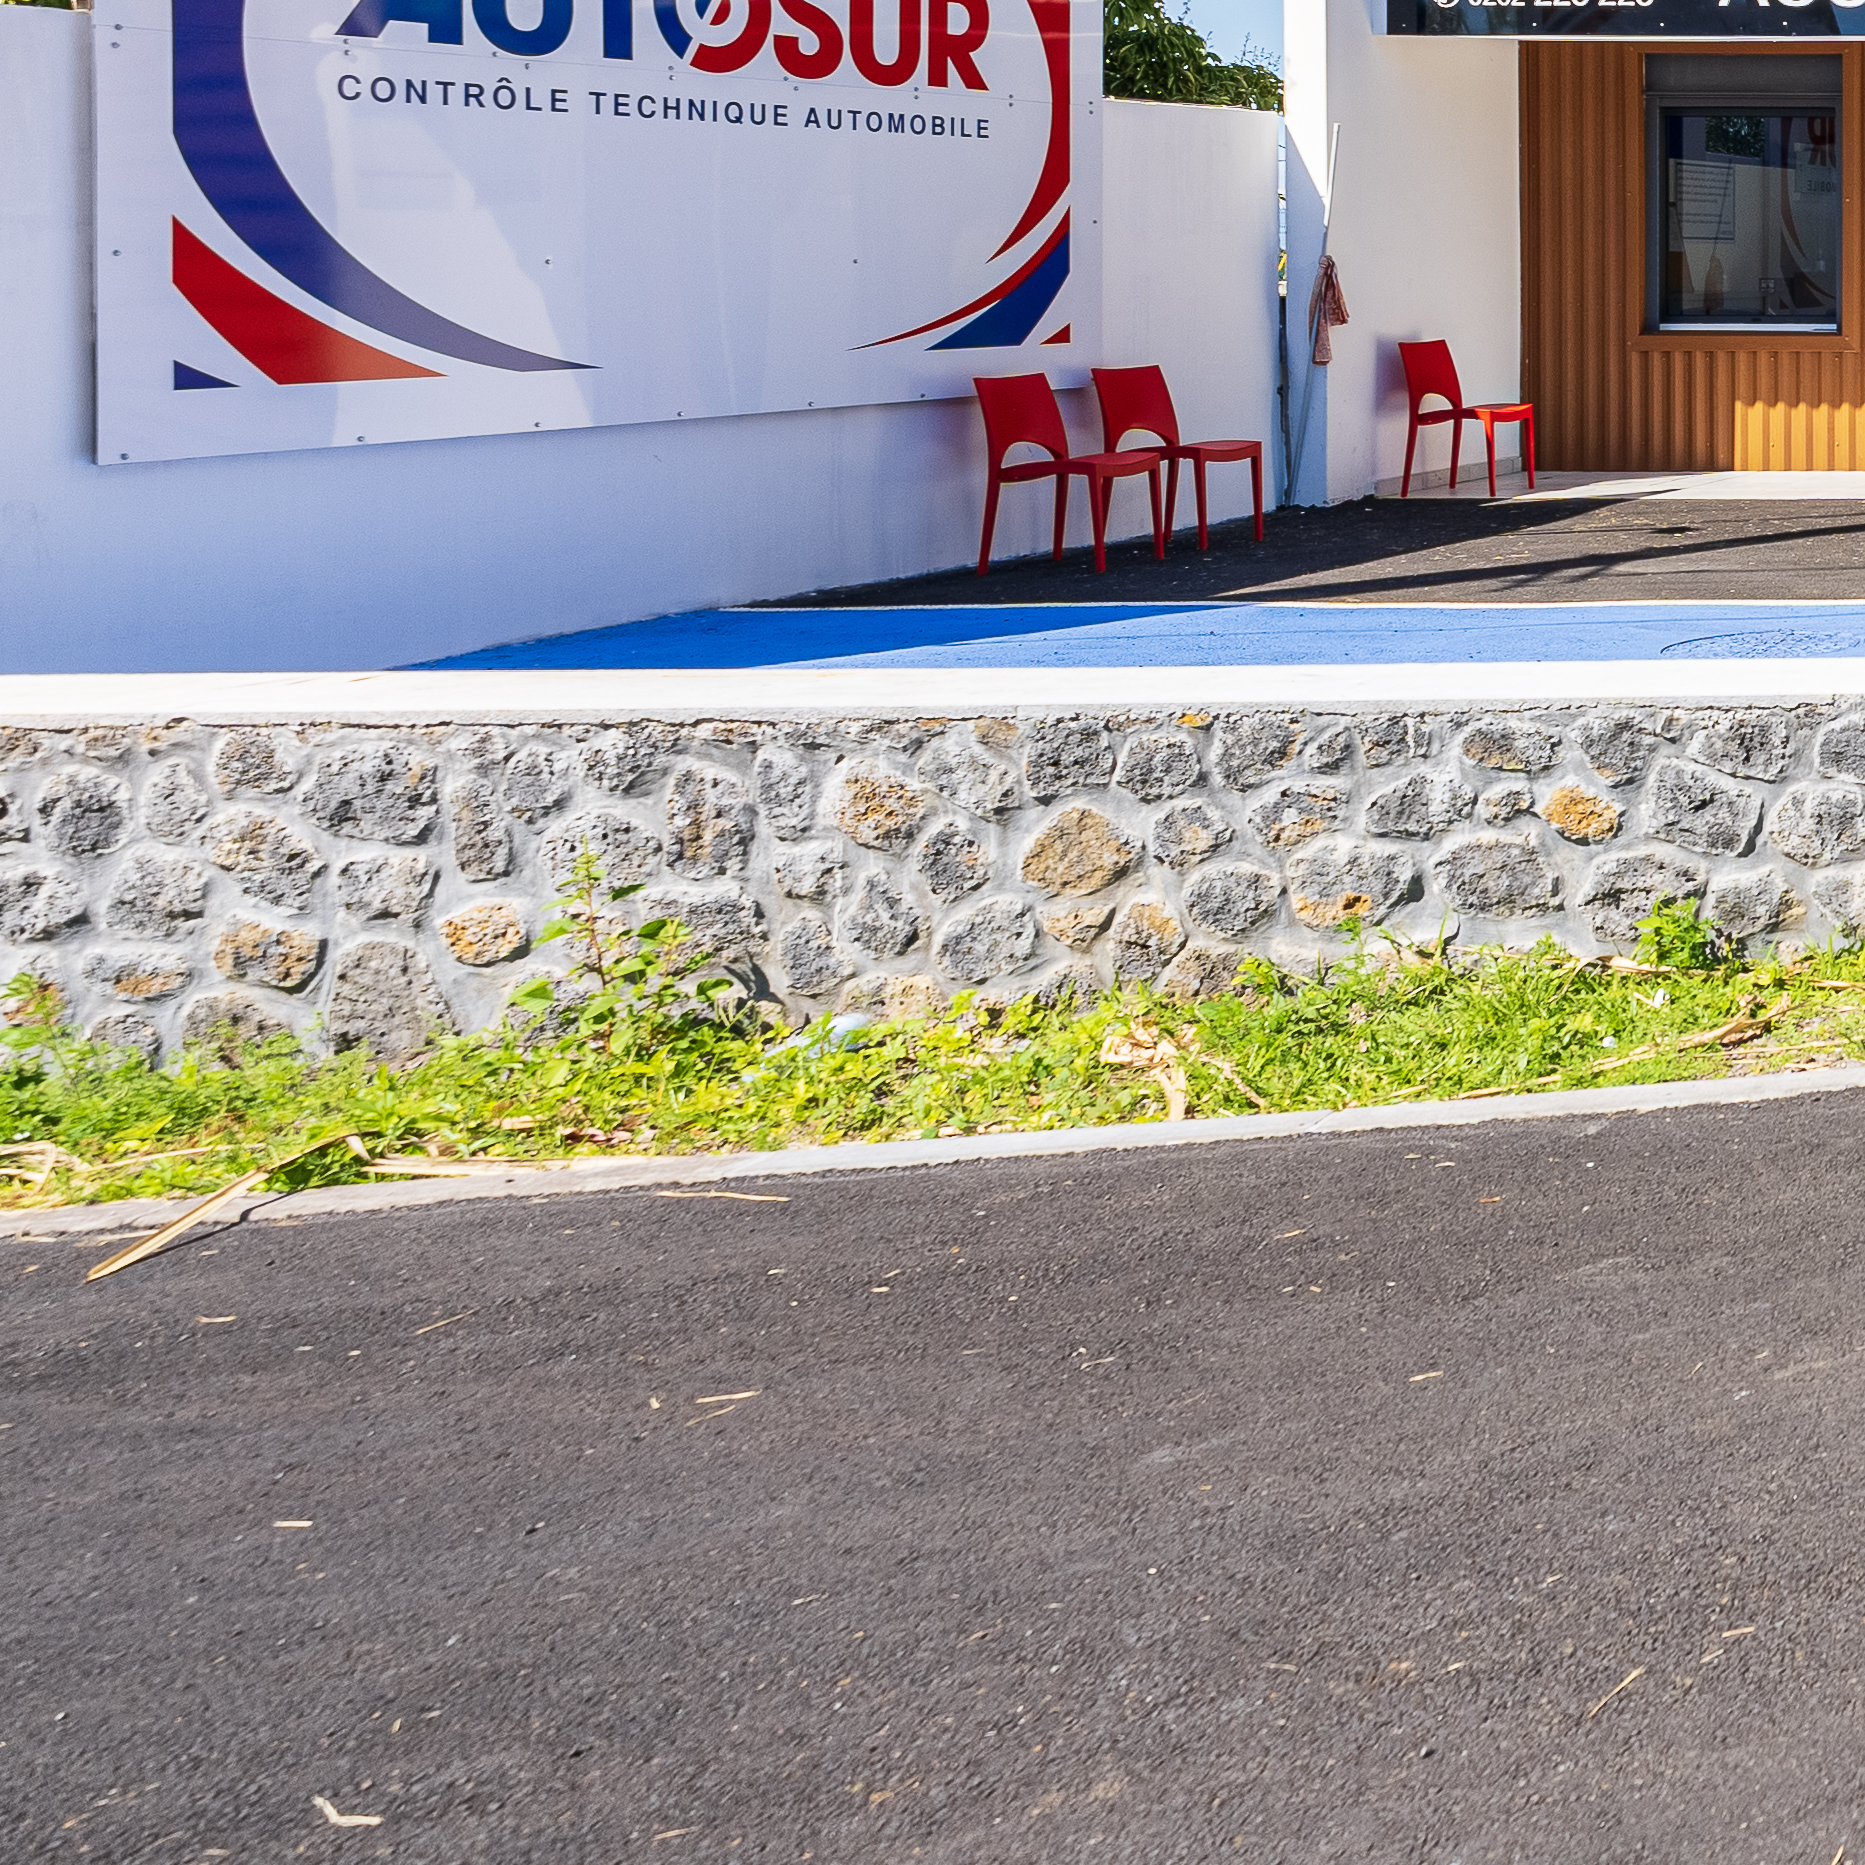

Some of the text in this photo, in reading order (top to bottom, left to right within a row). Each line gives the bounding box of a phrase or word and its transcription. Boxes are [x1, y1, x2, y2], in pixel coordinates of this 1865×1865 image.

[337, 73, 991, 140] CONTRÔLE TECHNIQUE AUTOMOBILE
